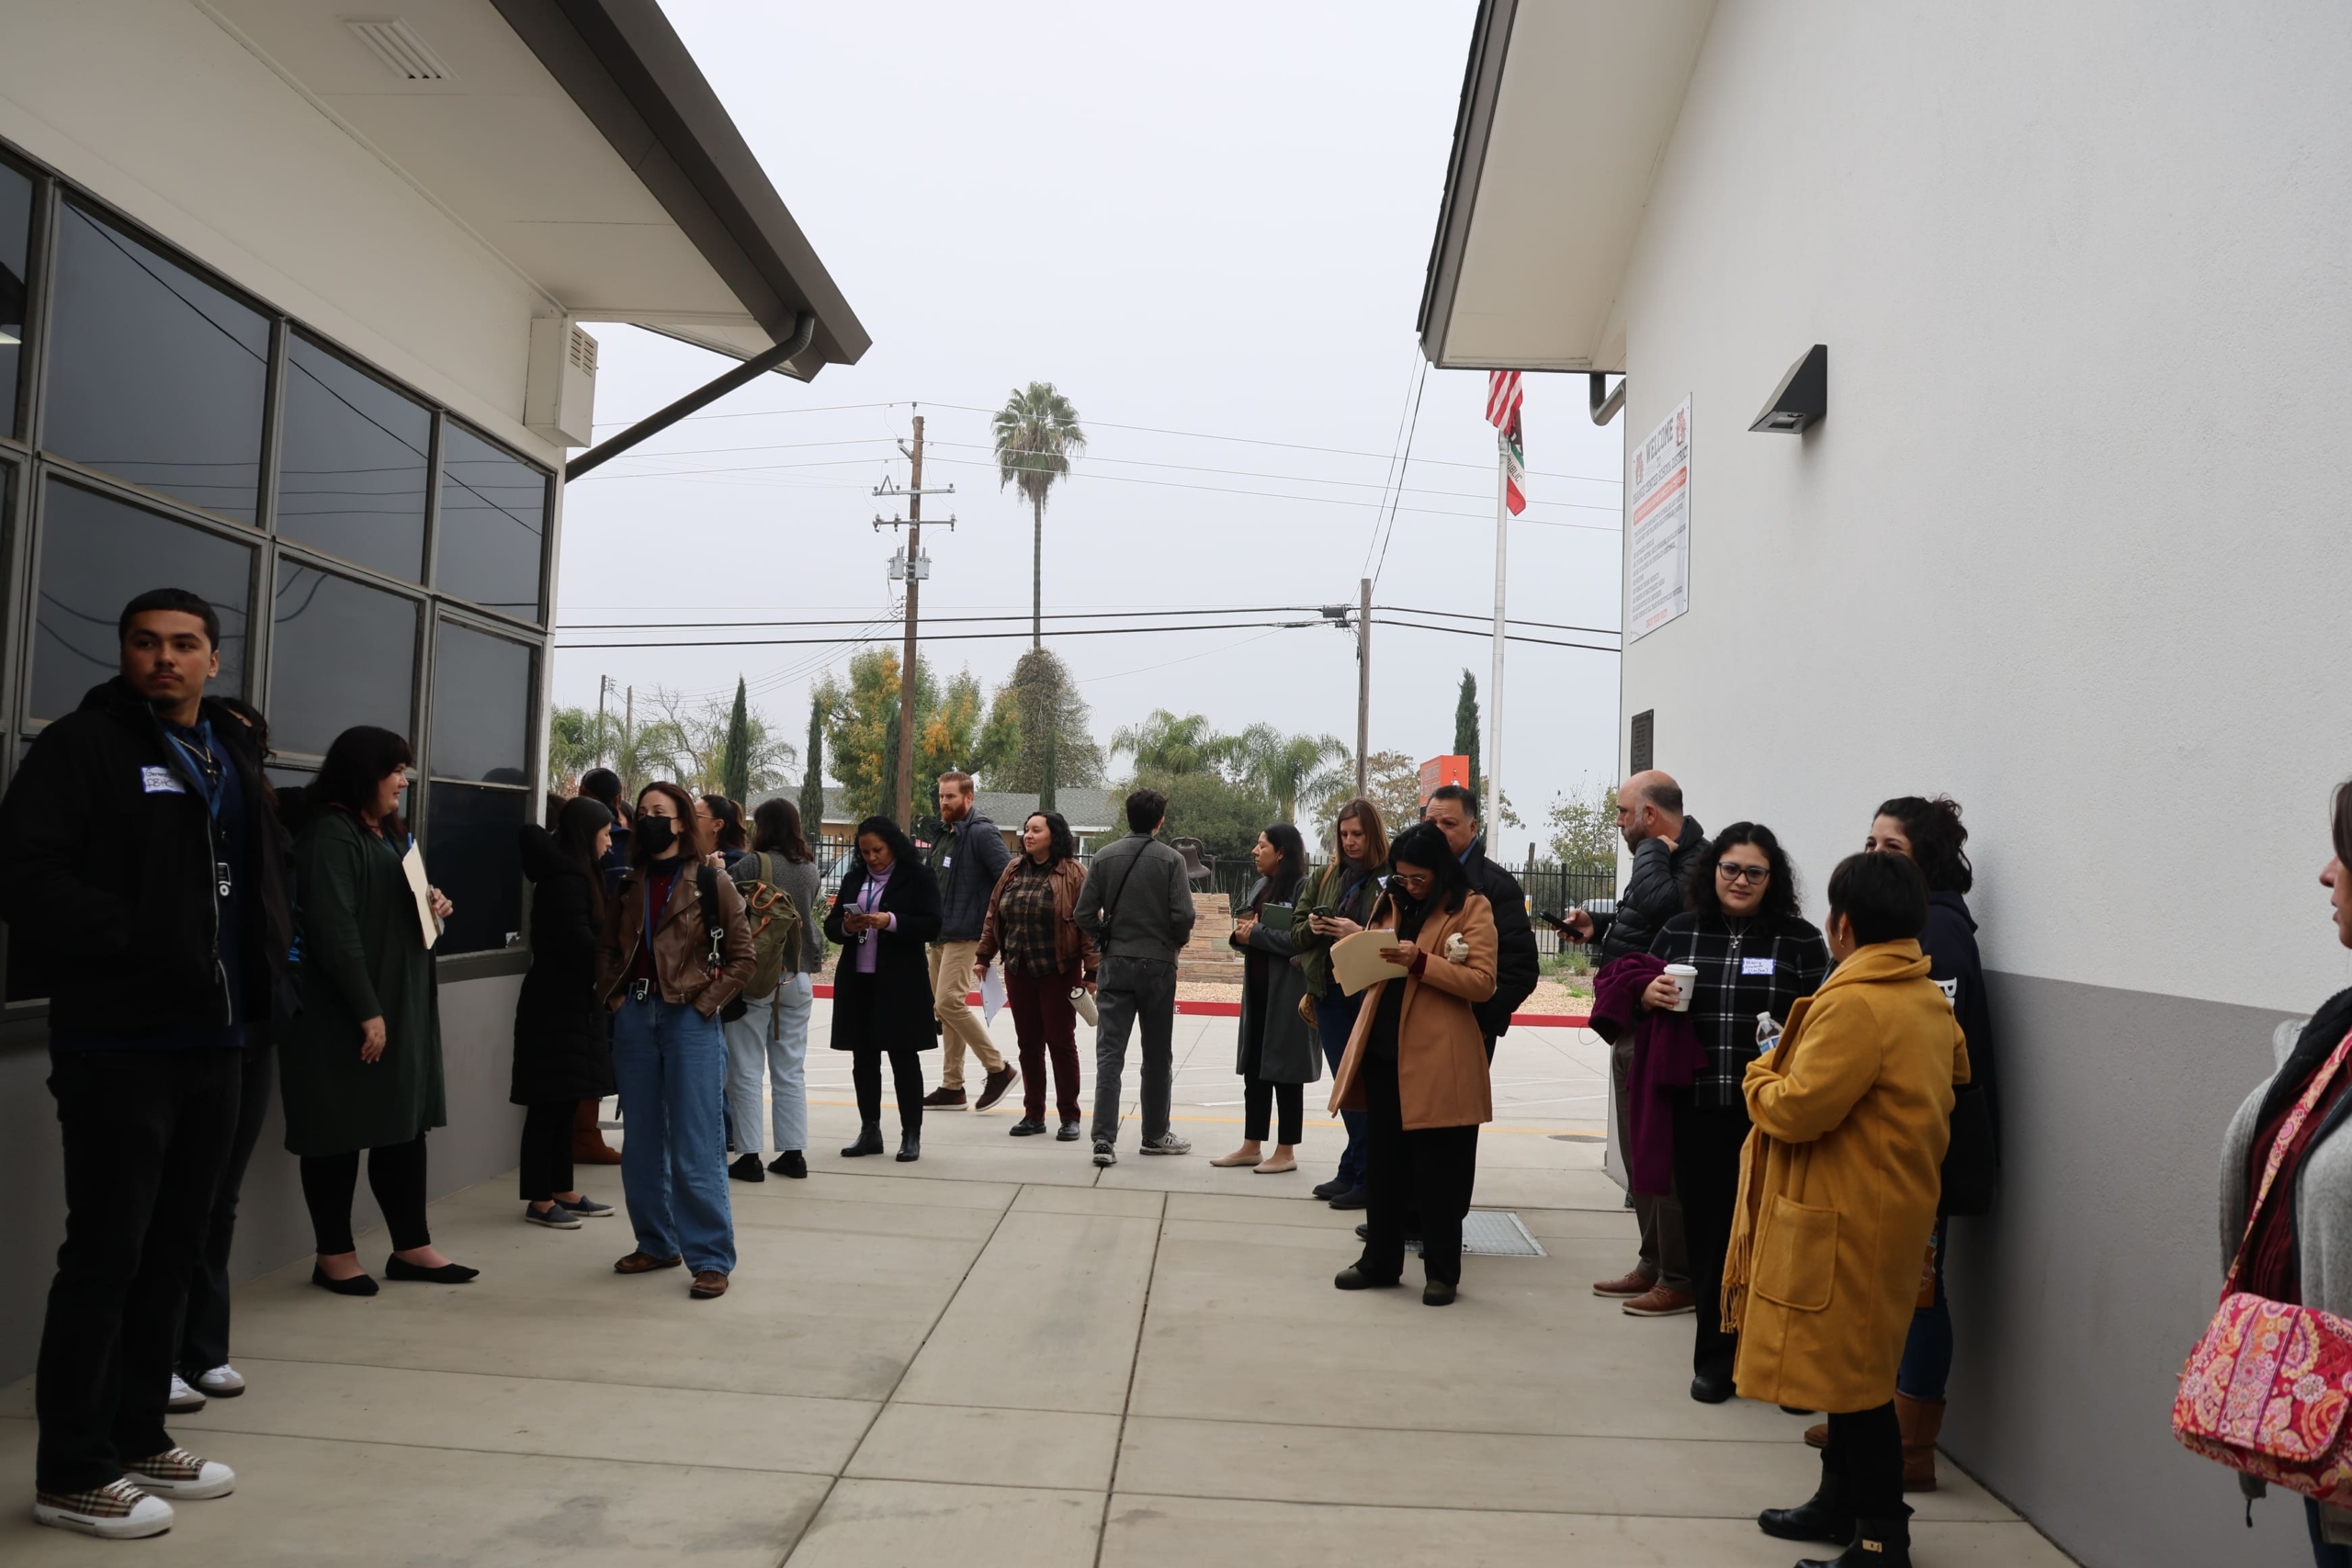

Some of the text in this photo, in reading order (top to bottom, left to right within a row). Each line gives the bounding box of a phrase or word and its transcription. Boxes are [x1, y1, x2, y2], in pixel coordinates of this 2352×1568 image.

[1645, 417, 1674, 464] WELCOME
[1658, 460, 1671, 481] SCHOOL
[1672, 445, 1689, 469] DISTRICT
